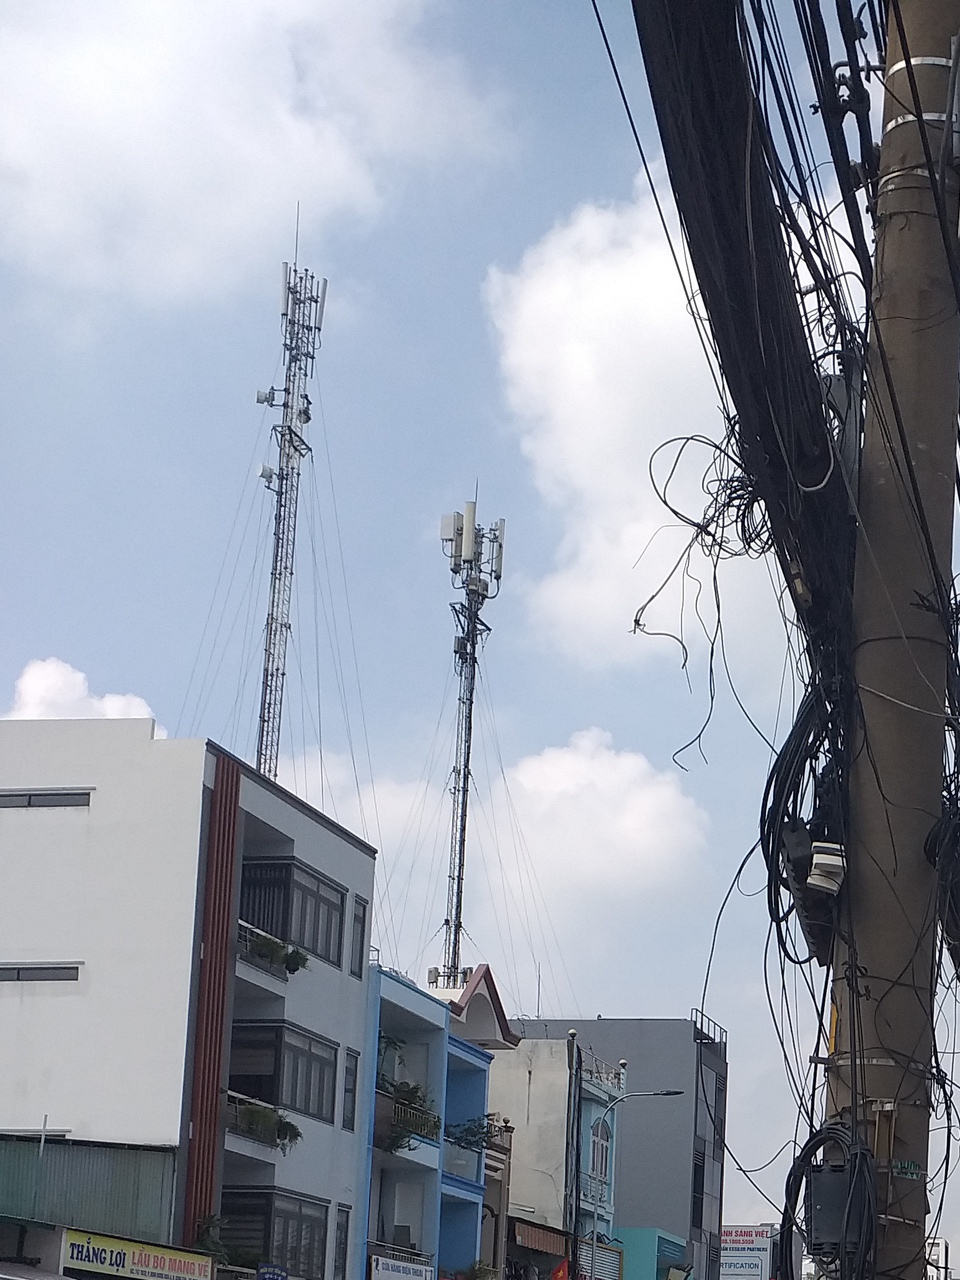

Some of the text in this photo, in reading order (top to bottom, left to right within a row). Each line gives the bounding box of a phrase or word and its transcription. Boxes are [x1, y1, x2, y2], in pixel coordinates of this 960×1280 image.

[69, 1237, 127, 1273] THẮNG LỢI
[168, 1257, 195, 1276] MANG
[720, 1262, 760, 1270] RTIFICATION
